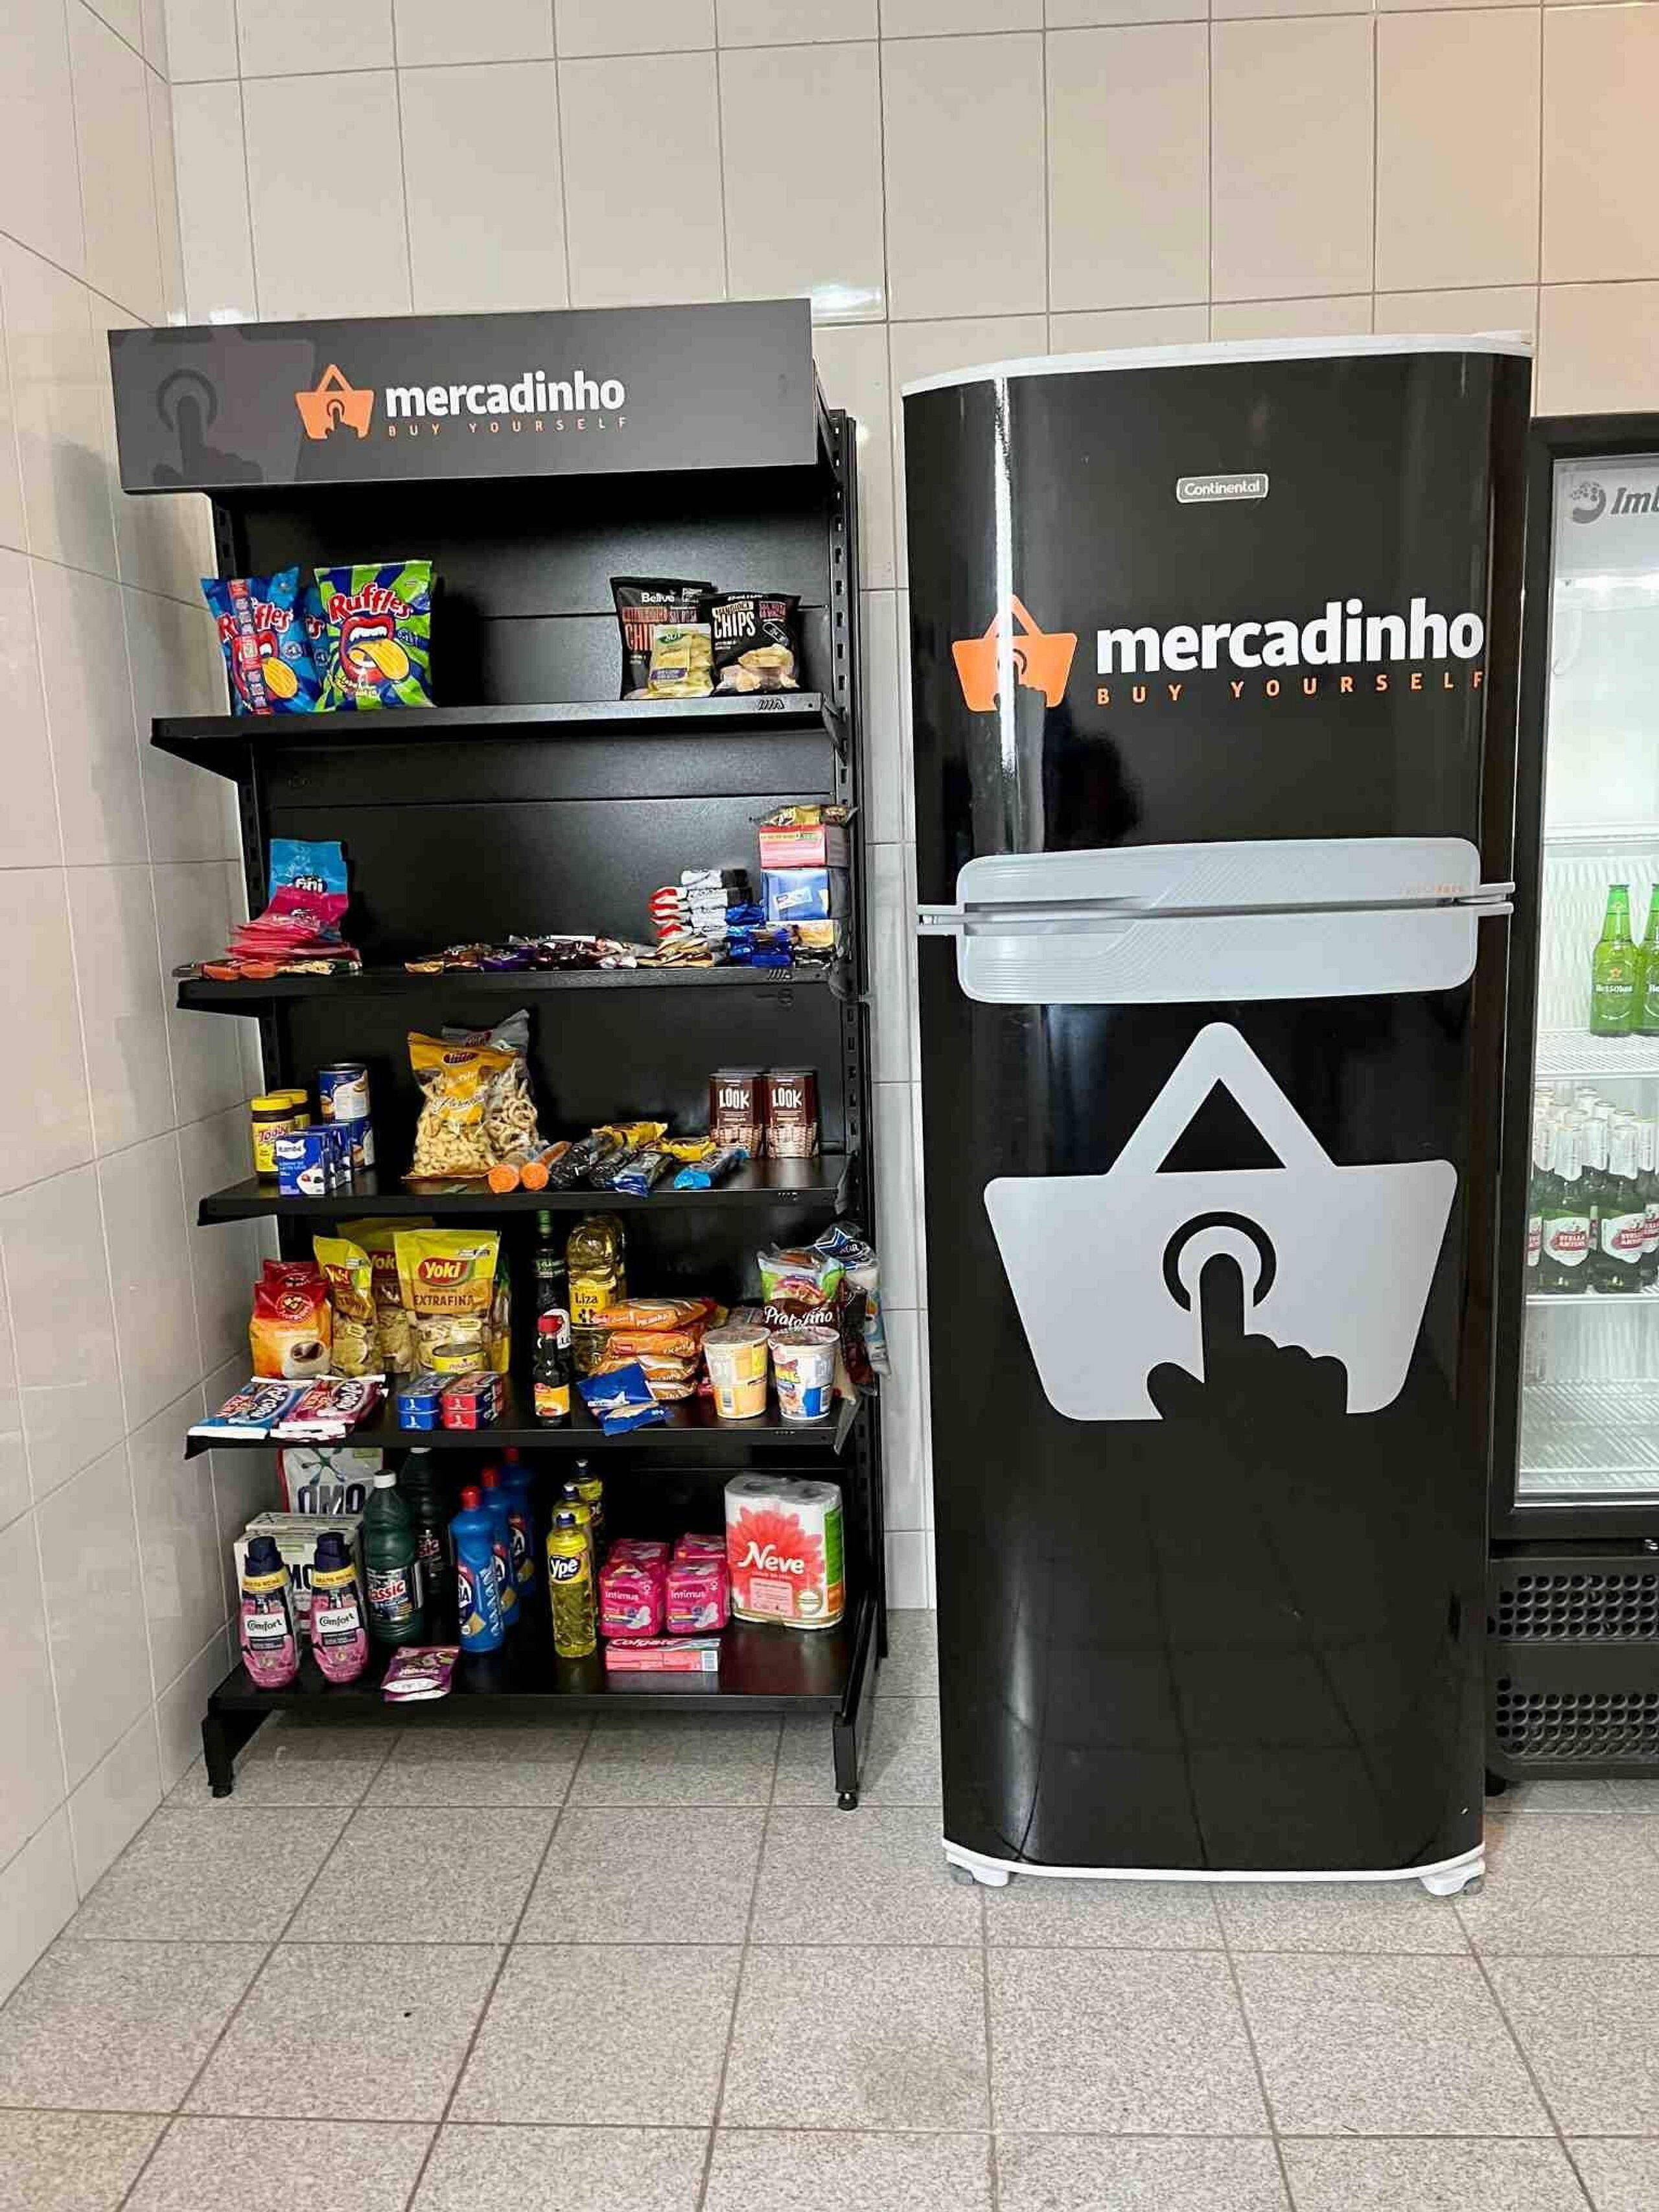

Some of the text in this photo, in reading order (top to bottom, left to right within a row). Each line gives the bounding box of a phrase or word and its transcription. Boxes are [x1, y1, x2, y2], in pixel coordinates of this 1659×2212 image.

[386, 370, 625, 417] mercadinho
[389, 417, 627, 437] BUY YOURSELF
[1183, 478, 1262, 496] Continental
[327, 583, 413, 624] Ruffles
[216, 598, 294, 644] Rfles
[714, 611, 756, 638] CHIPS
[1096, 597, 1485, 675] mercadinho
[1097, 671, 1485, 706] BUY YOURSELF
[719, 1088, 750, 1109] LOOK
[772, 1088, 802, 1108] LOOK
[424, 1261, 462, 1279] Yoki
[574, 1292, 599, 1304] Liza
[737, 1540, 805, 1575] Neve
[319, 1612, 355, 1627] Comfort
